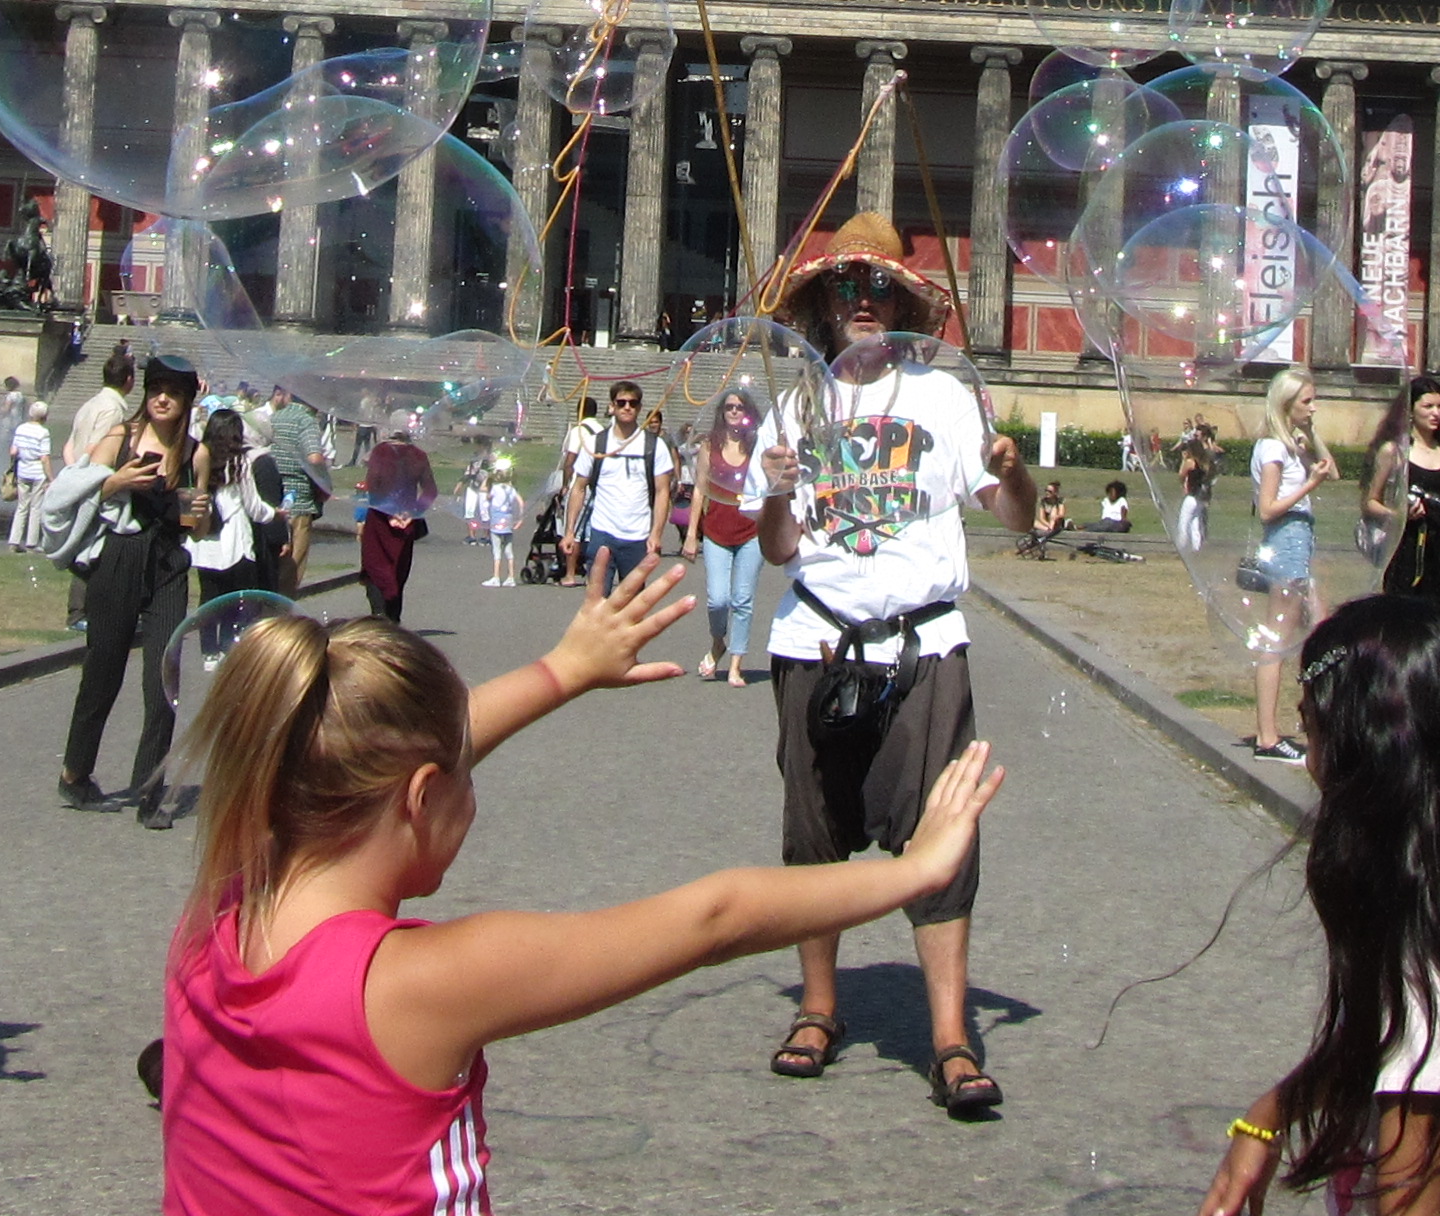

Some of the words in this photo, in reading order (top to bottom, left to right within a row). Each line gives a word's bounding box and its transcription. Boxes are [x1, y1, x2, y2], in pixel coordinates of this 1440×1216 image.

[1250, 173, 1292, 325] Fleisch
[1361, 231, 1383, 302] NEUE
[831, 472, 856, 489] AIR
[859, 470, 898, 486] BASE
